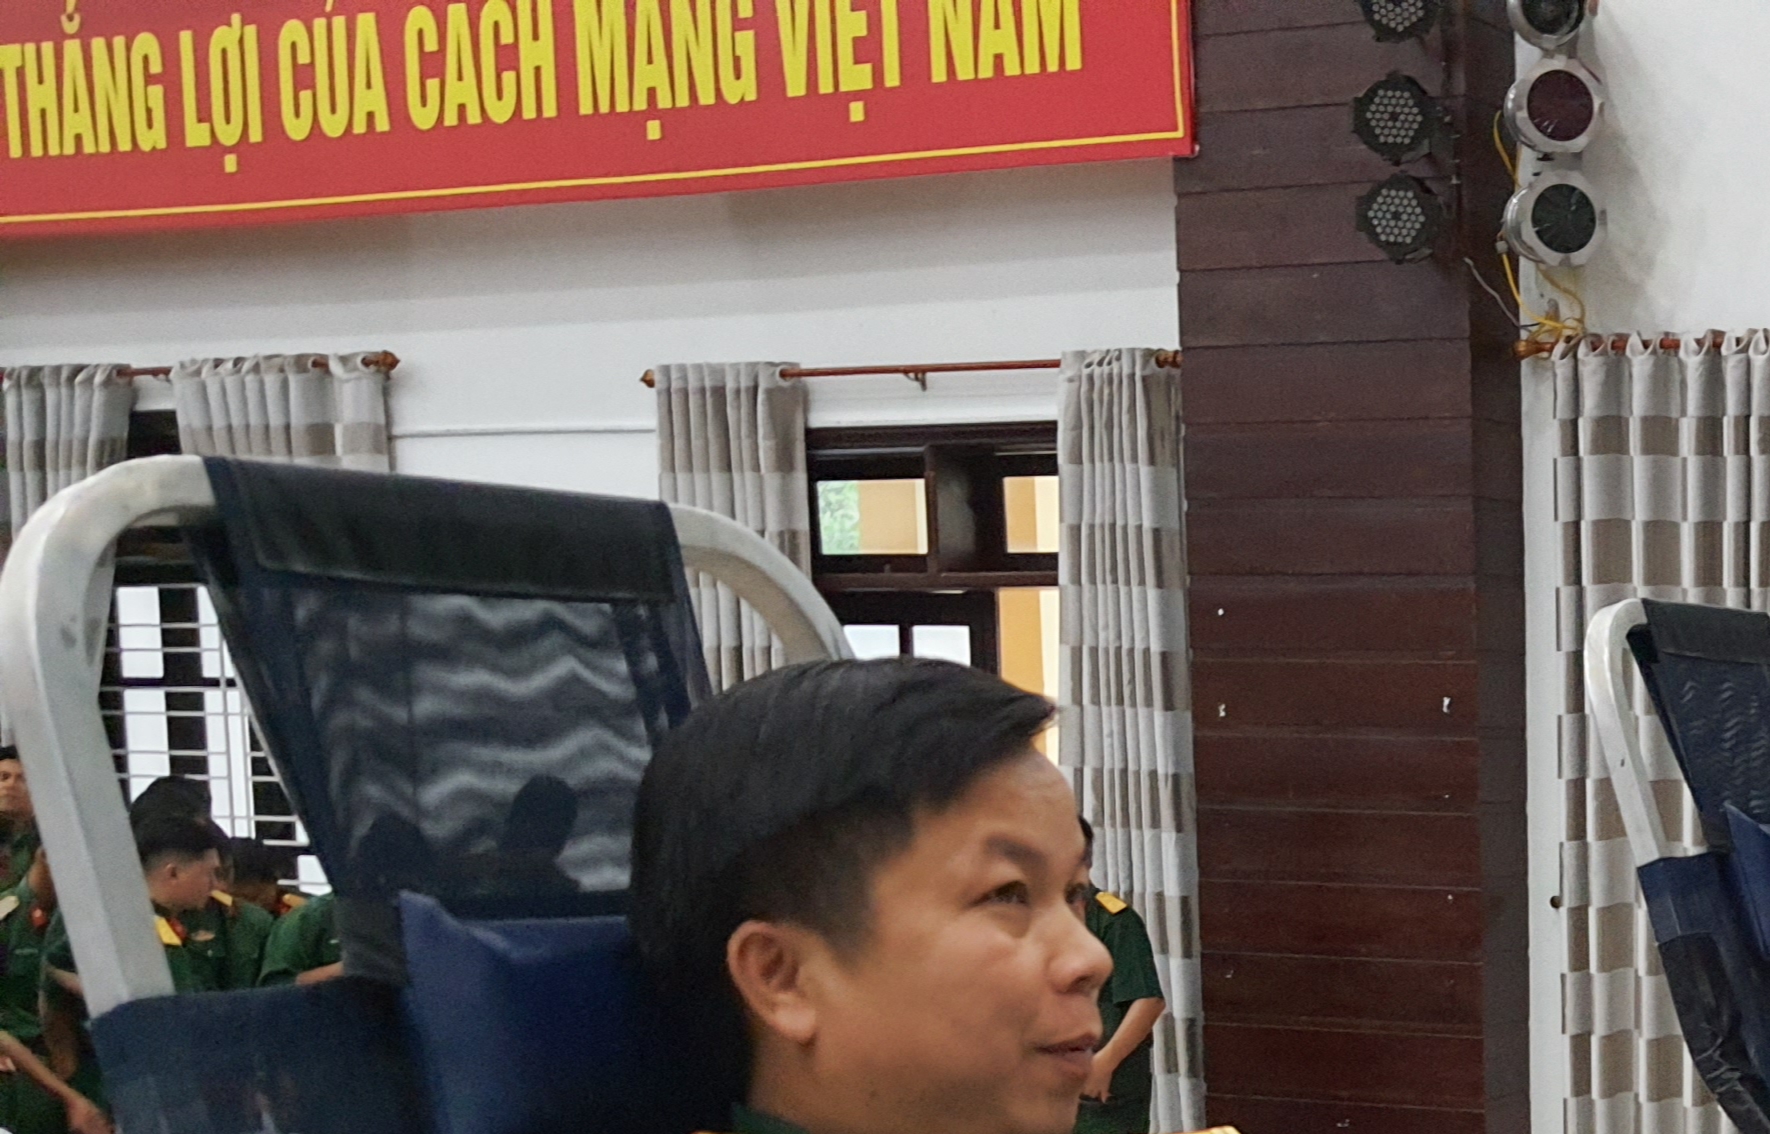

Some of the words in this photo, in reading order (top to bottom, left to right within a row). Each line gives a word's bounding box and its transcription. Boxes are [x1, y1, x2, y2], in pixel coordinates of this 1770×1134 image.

[179, 12, 263, 173] LỢI
[573, 0, 757, 140] MẠNG
[928, 0, 1082, 83] NAM
